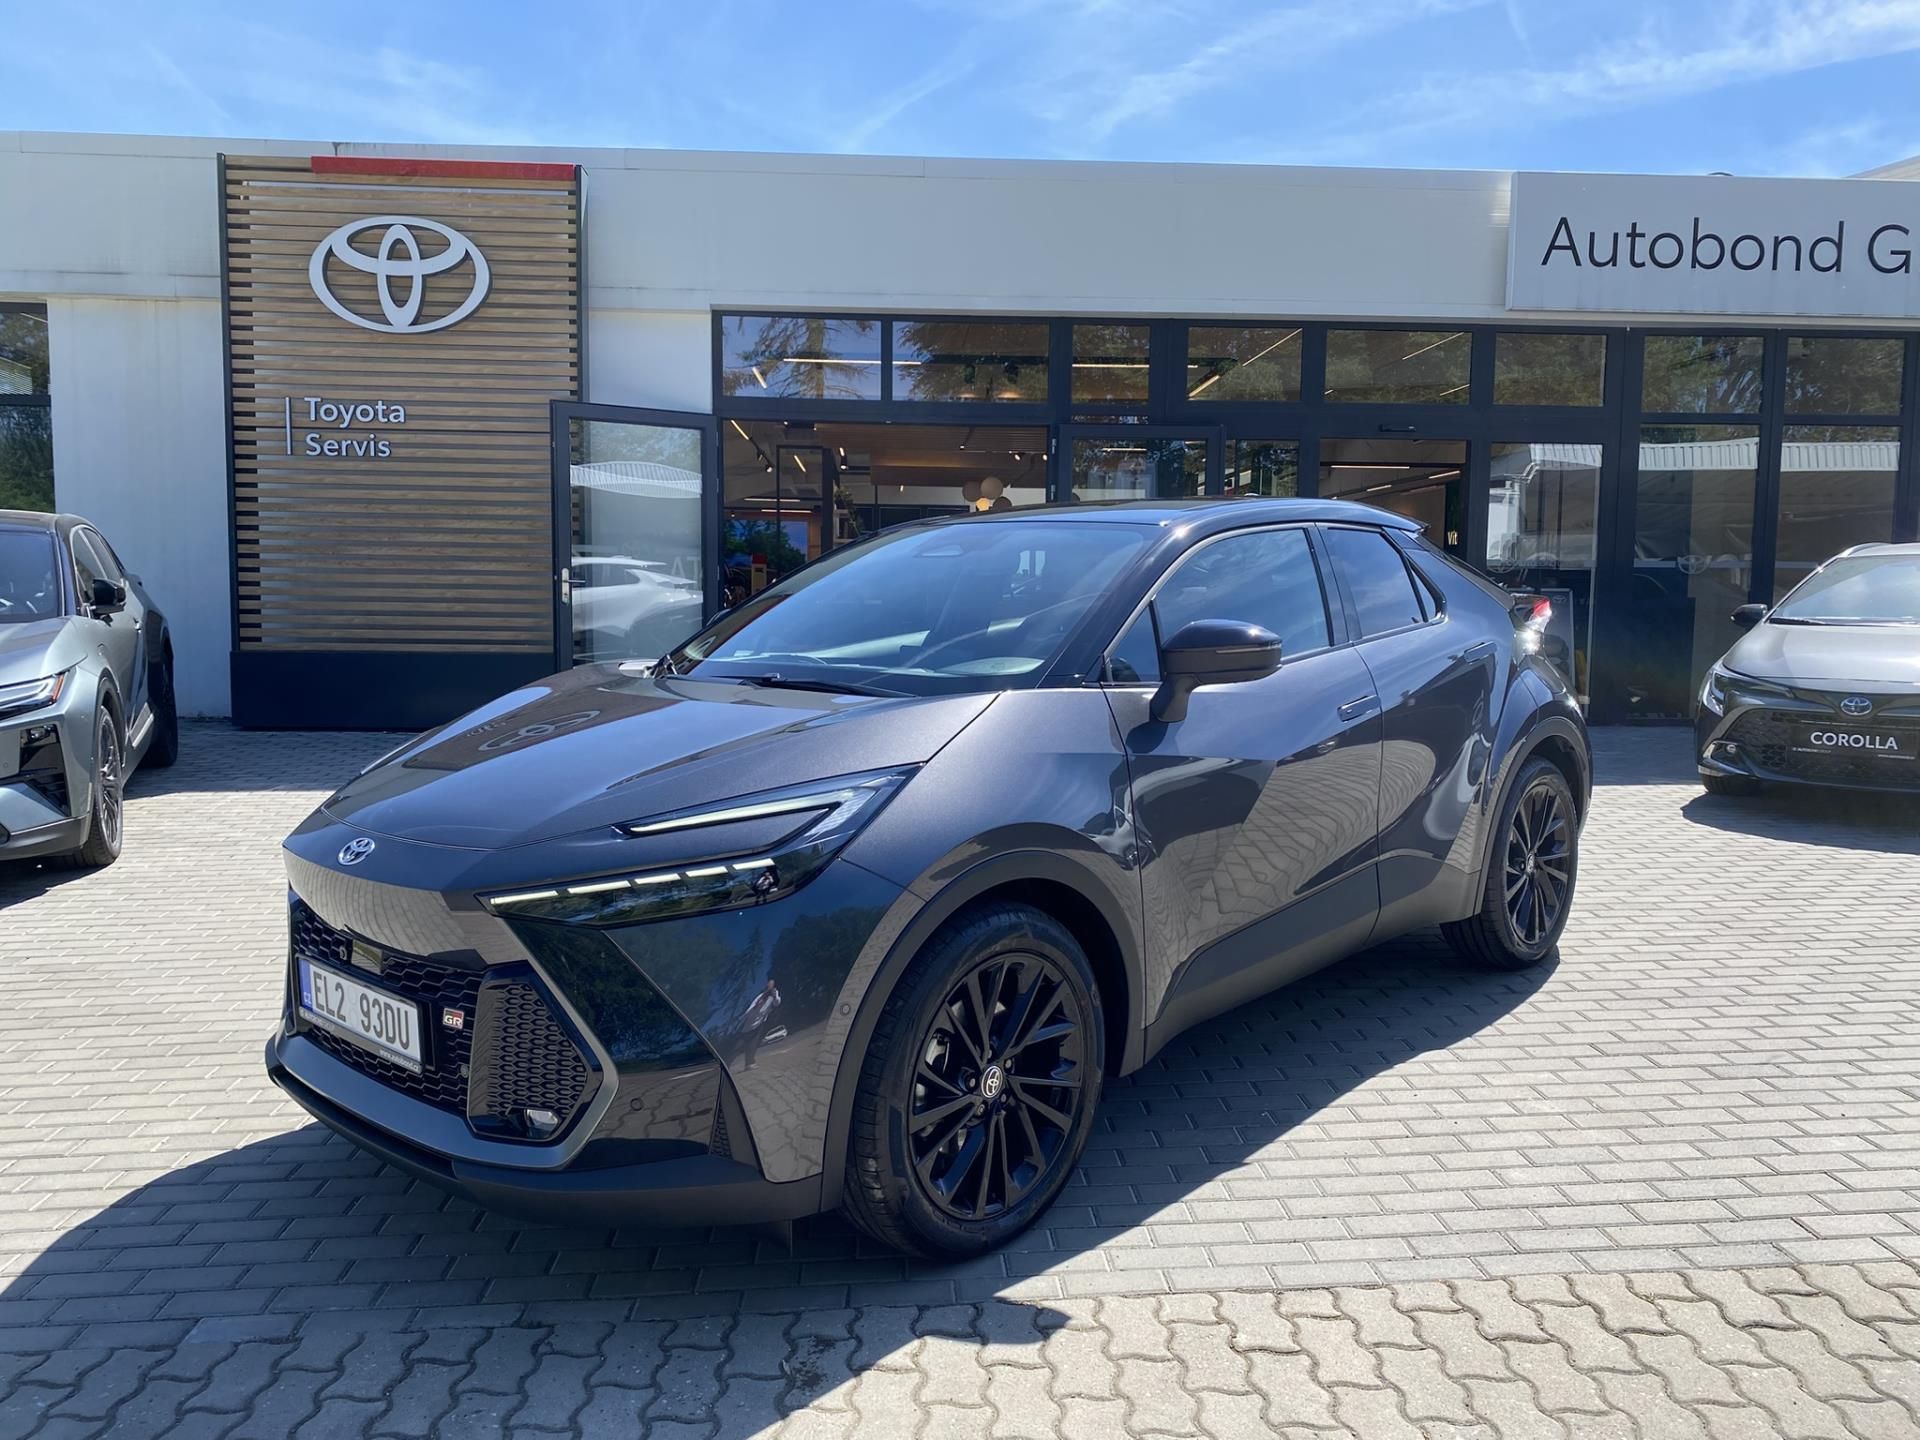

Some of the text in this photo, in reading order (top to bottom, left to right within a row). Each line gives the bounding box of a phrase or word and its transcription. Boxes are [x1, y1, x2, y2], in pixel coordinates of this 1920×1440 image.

[1541, 217, 1845, 273] Autobond
[304, 396, 406, 429] Toyota
[305, 433, 392, 457] Servis
[1810, 732, 1898, 750] COROLLA
[313, 971, 346, 1023] EL2
[359, 993, 410, 1050] 93DU
[444, 1014, 463, 1028] GR
